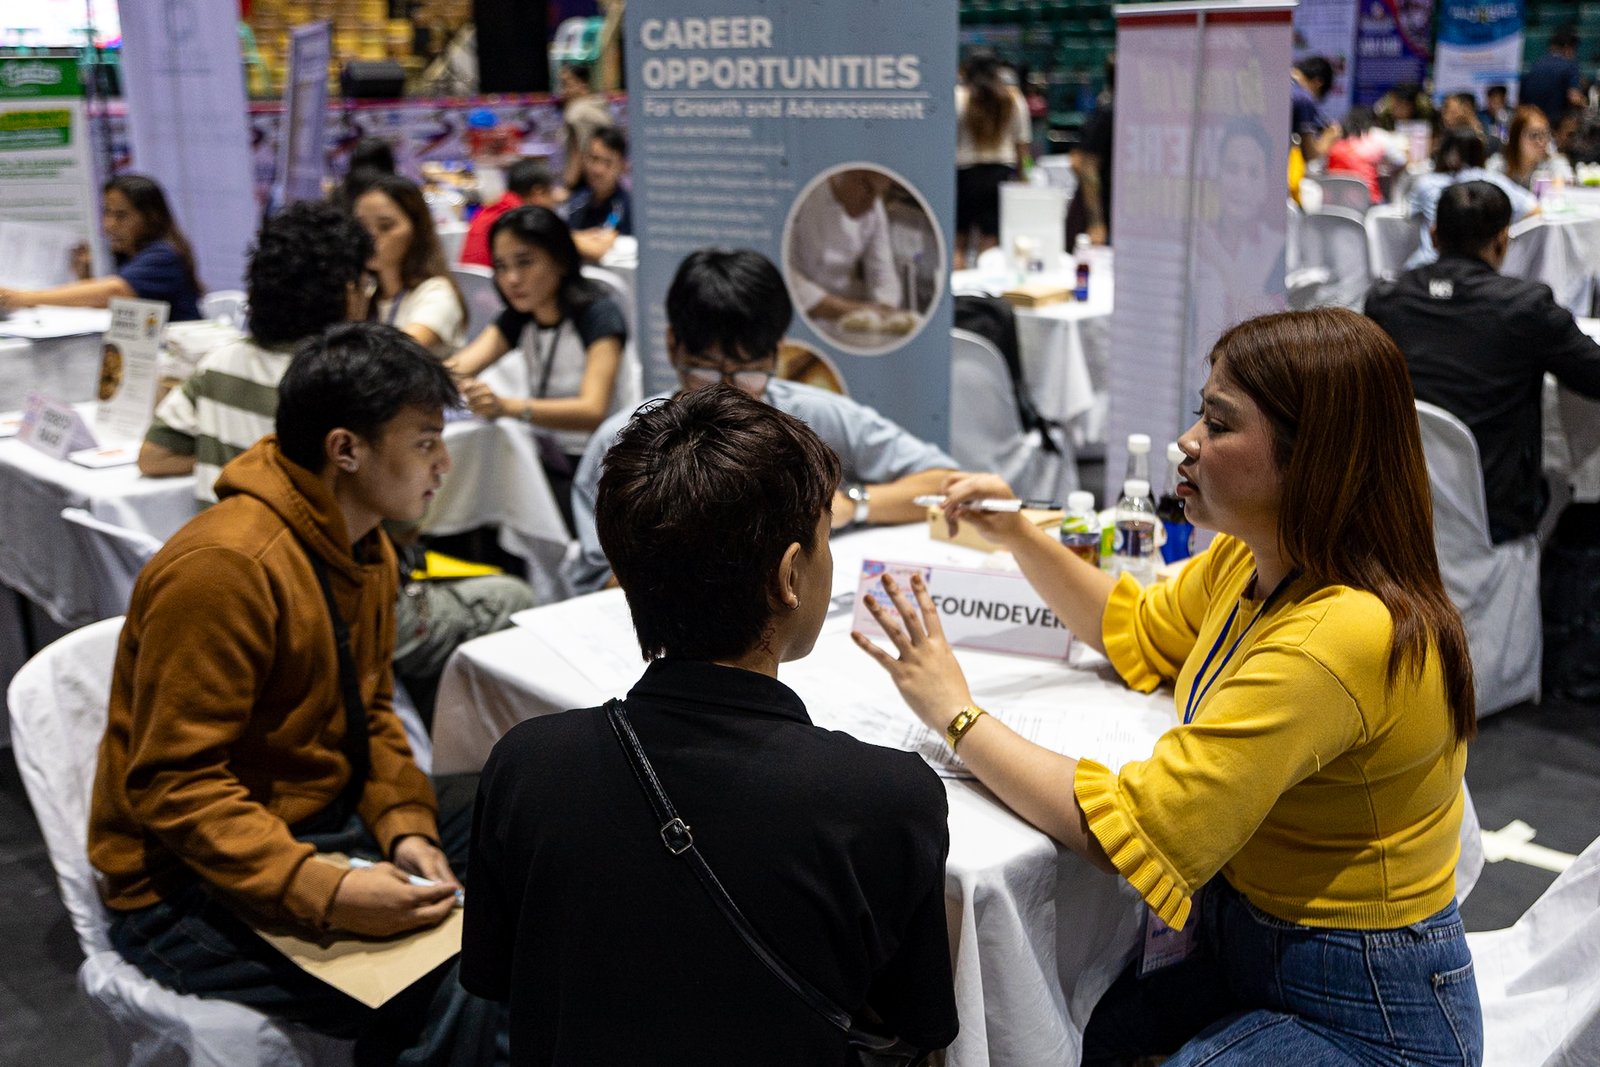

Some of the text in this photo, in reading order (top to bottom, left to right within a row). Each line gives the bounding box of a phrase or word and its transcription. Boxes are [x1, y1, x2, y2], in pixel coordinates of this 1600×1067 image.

[641, 17, 772, 50] CAREER
[642, 55, 921, 89] OPPORTUNITIES
[644, 98, 924, 119] For Growth and Advancement
